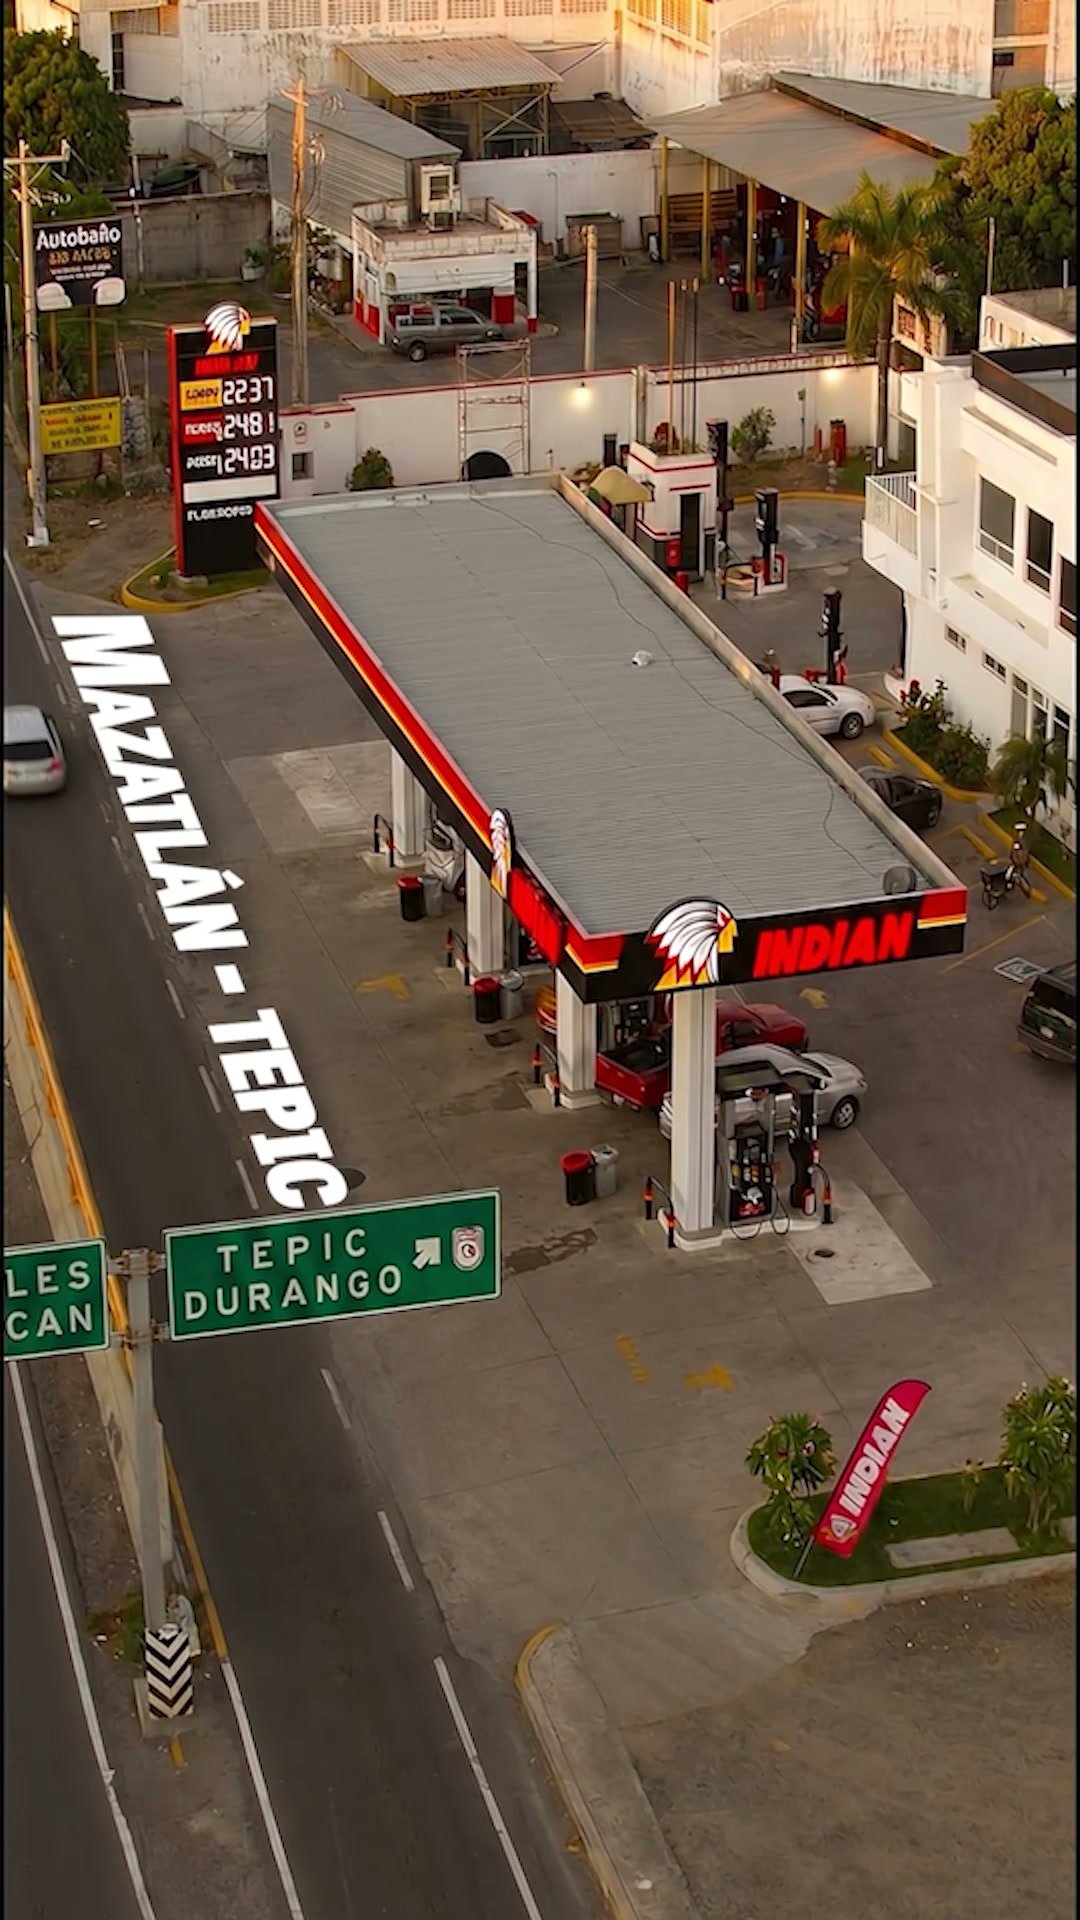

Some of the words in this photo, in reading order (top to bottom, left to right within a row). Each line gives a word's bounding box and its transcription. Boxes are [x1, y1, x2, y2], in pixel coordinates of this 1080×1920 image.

[752, 911, 916, 979] INDIAN
[216, 1228, 368, 1274] TEPIC
[6, 1259, 92, 1297] LES
[184, 1264, 402, 1321] DURANGO
[5, 1302, 94, 1342] CAN
[838, 1396, 911, 1518] INDIAN
